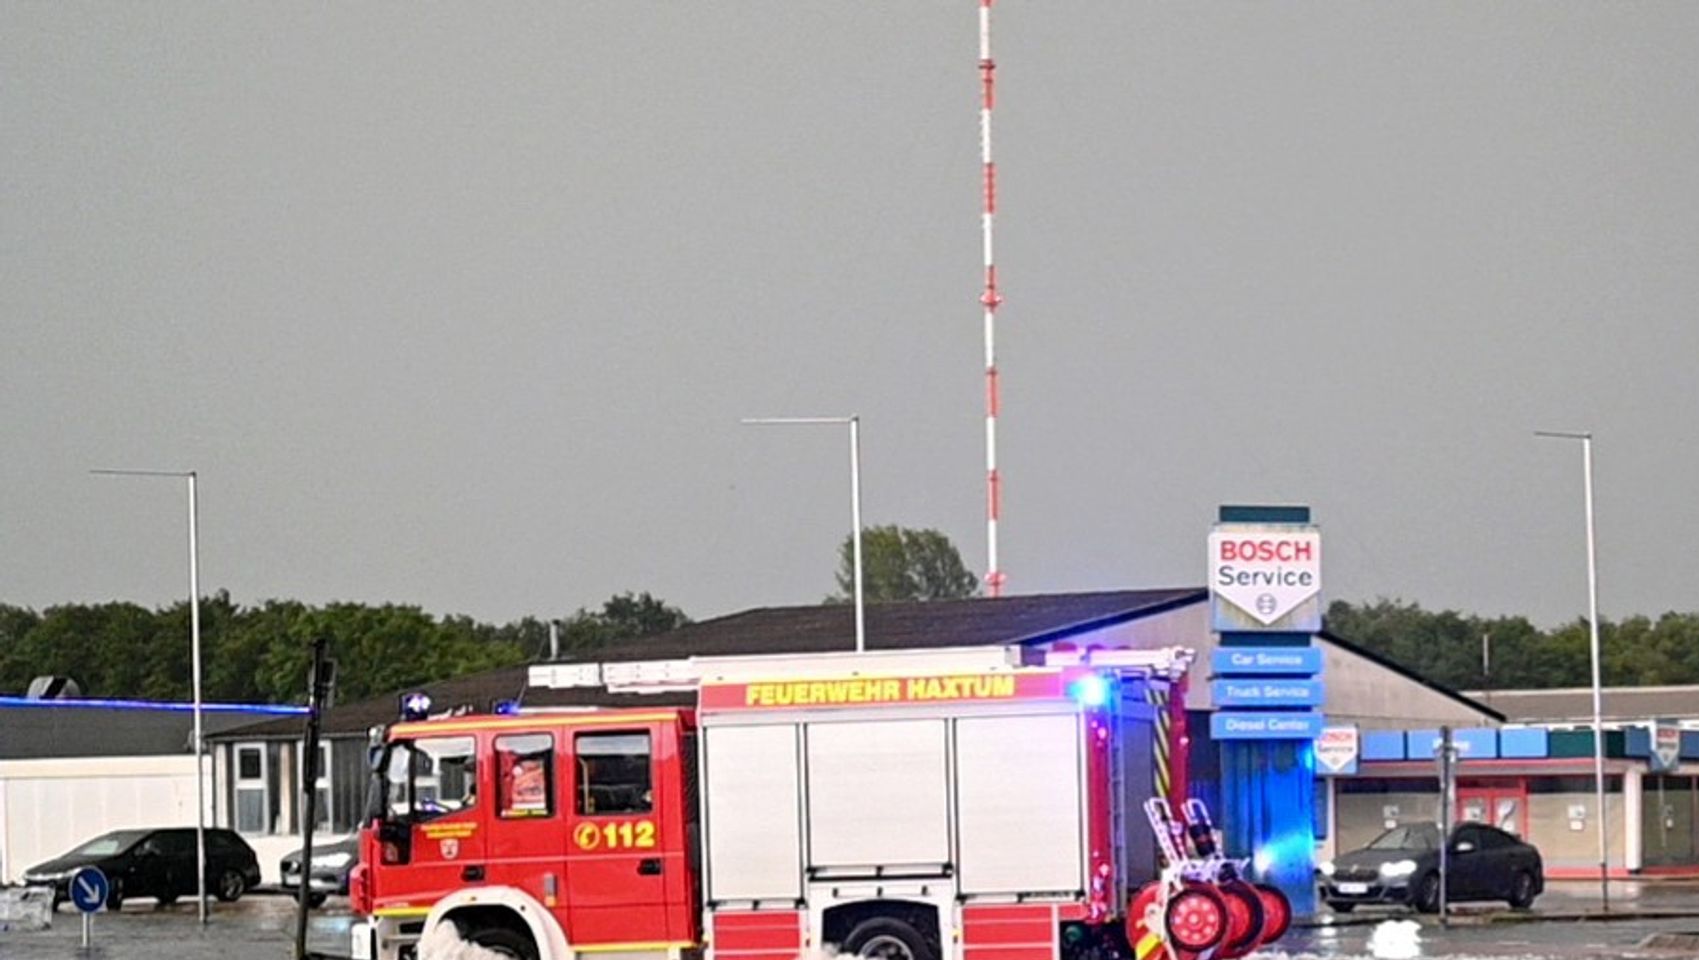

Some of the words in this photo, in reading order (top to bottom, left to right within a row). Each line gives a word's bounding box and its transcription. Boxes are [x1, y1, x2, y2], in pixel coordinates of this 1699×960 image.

[1221, 541, 1311, 560] BOSCH
[1219, 565, 1312, 586] Service
[1231, 654, 1253, 665] Car
[1257, 653, 1303, 665] Service
[746, 679, 900, 705] FEUERWEHR
[907, 676, 1014, 699] HAXTUM
[1227, 686, 1259, 697] Truck
[1263, 685, 1309, 697] Service
[1225, 719, 1265, 731] Diesel
[1268, 718, 1309, 730] Center
[604, 821, 655, 848] 112
